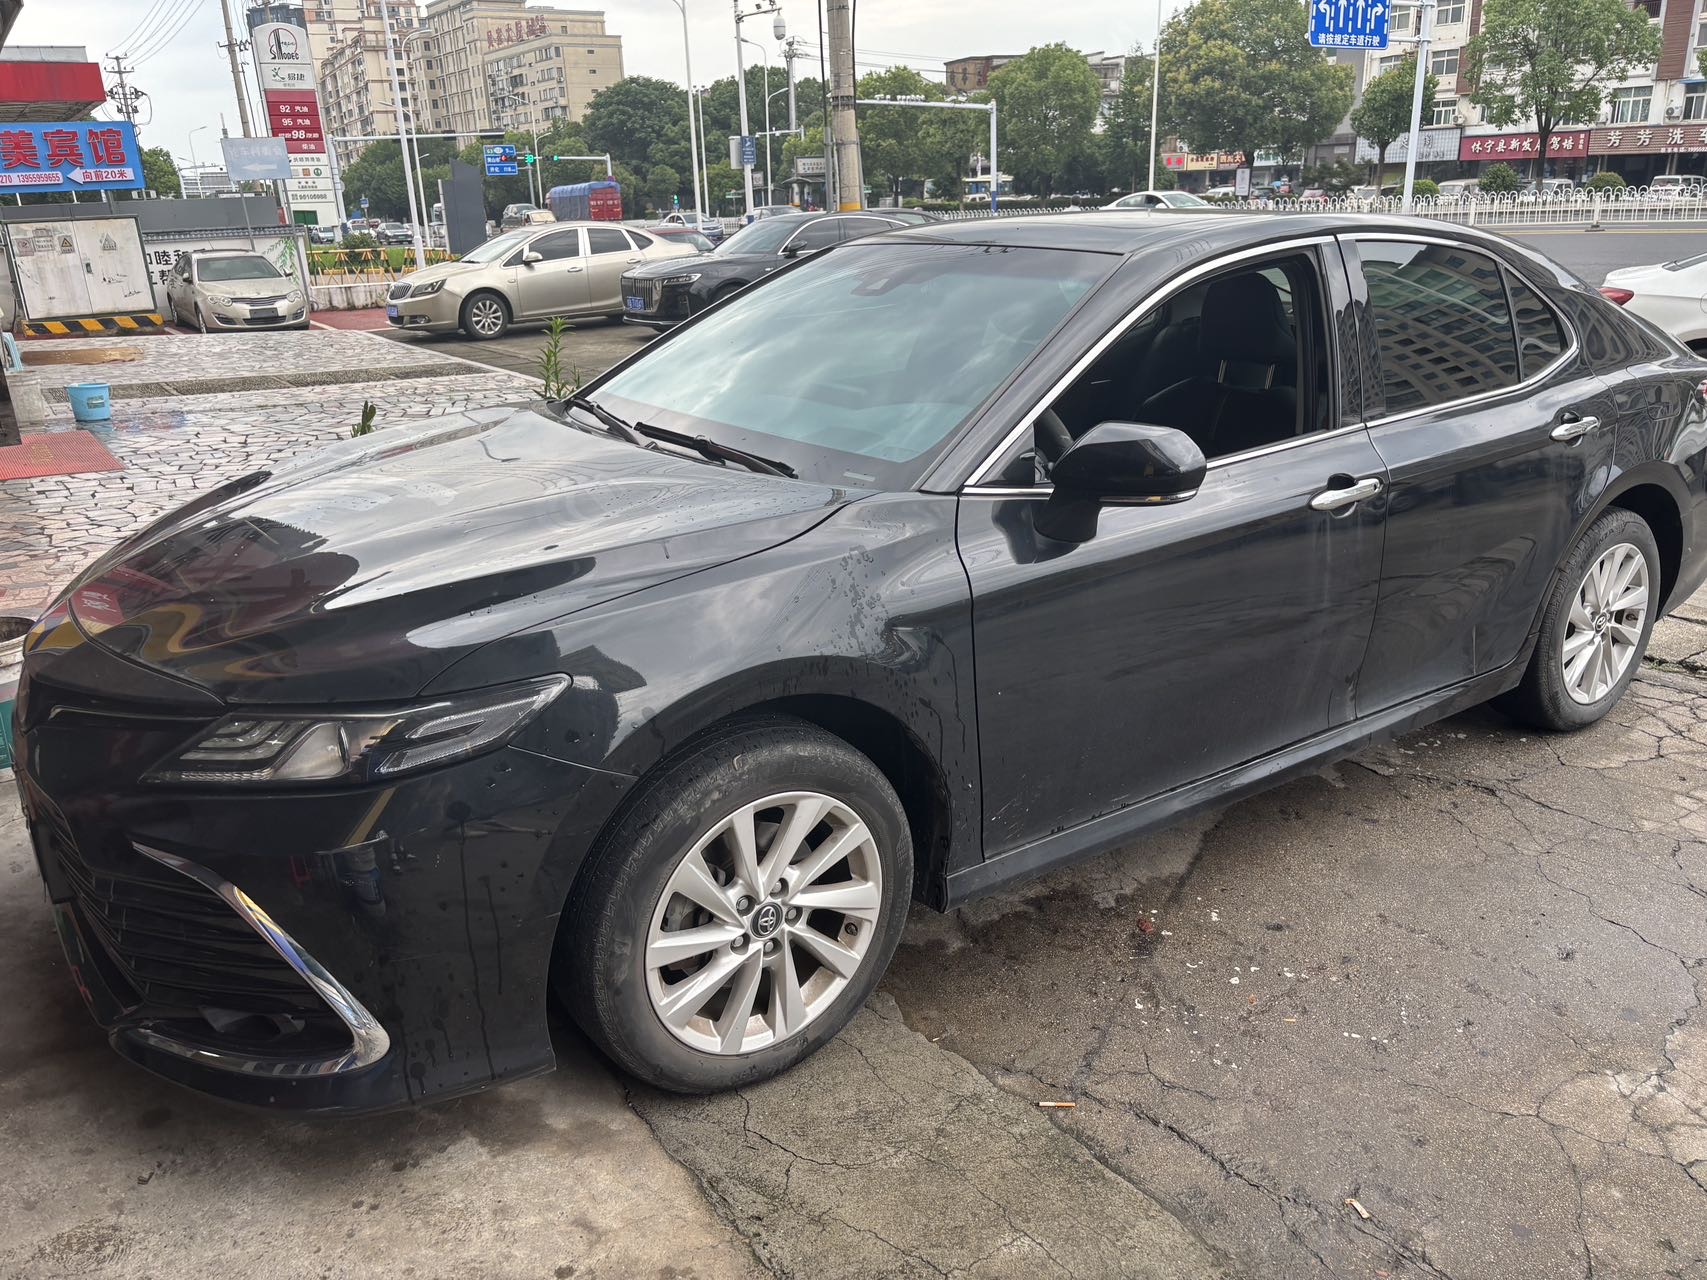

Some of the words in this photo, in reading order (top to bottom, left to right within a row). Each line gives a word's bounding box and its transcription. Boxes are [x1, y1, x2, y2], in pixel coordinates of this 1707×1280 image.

[1318, 33, 1380, 46] 请按规定车道行驶
[0, 129, 127, 168] 美宾馆
[17, 173, 60, 183] 13955959655
[83, 170, 127, 180] 向前20米
